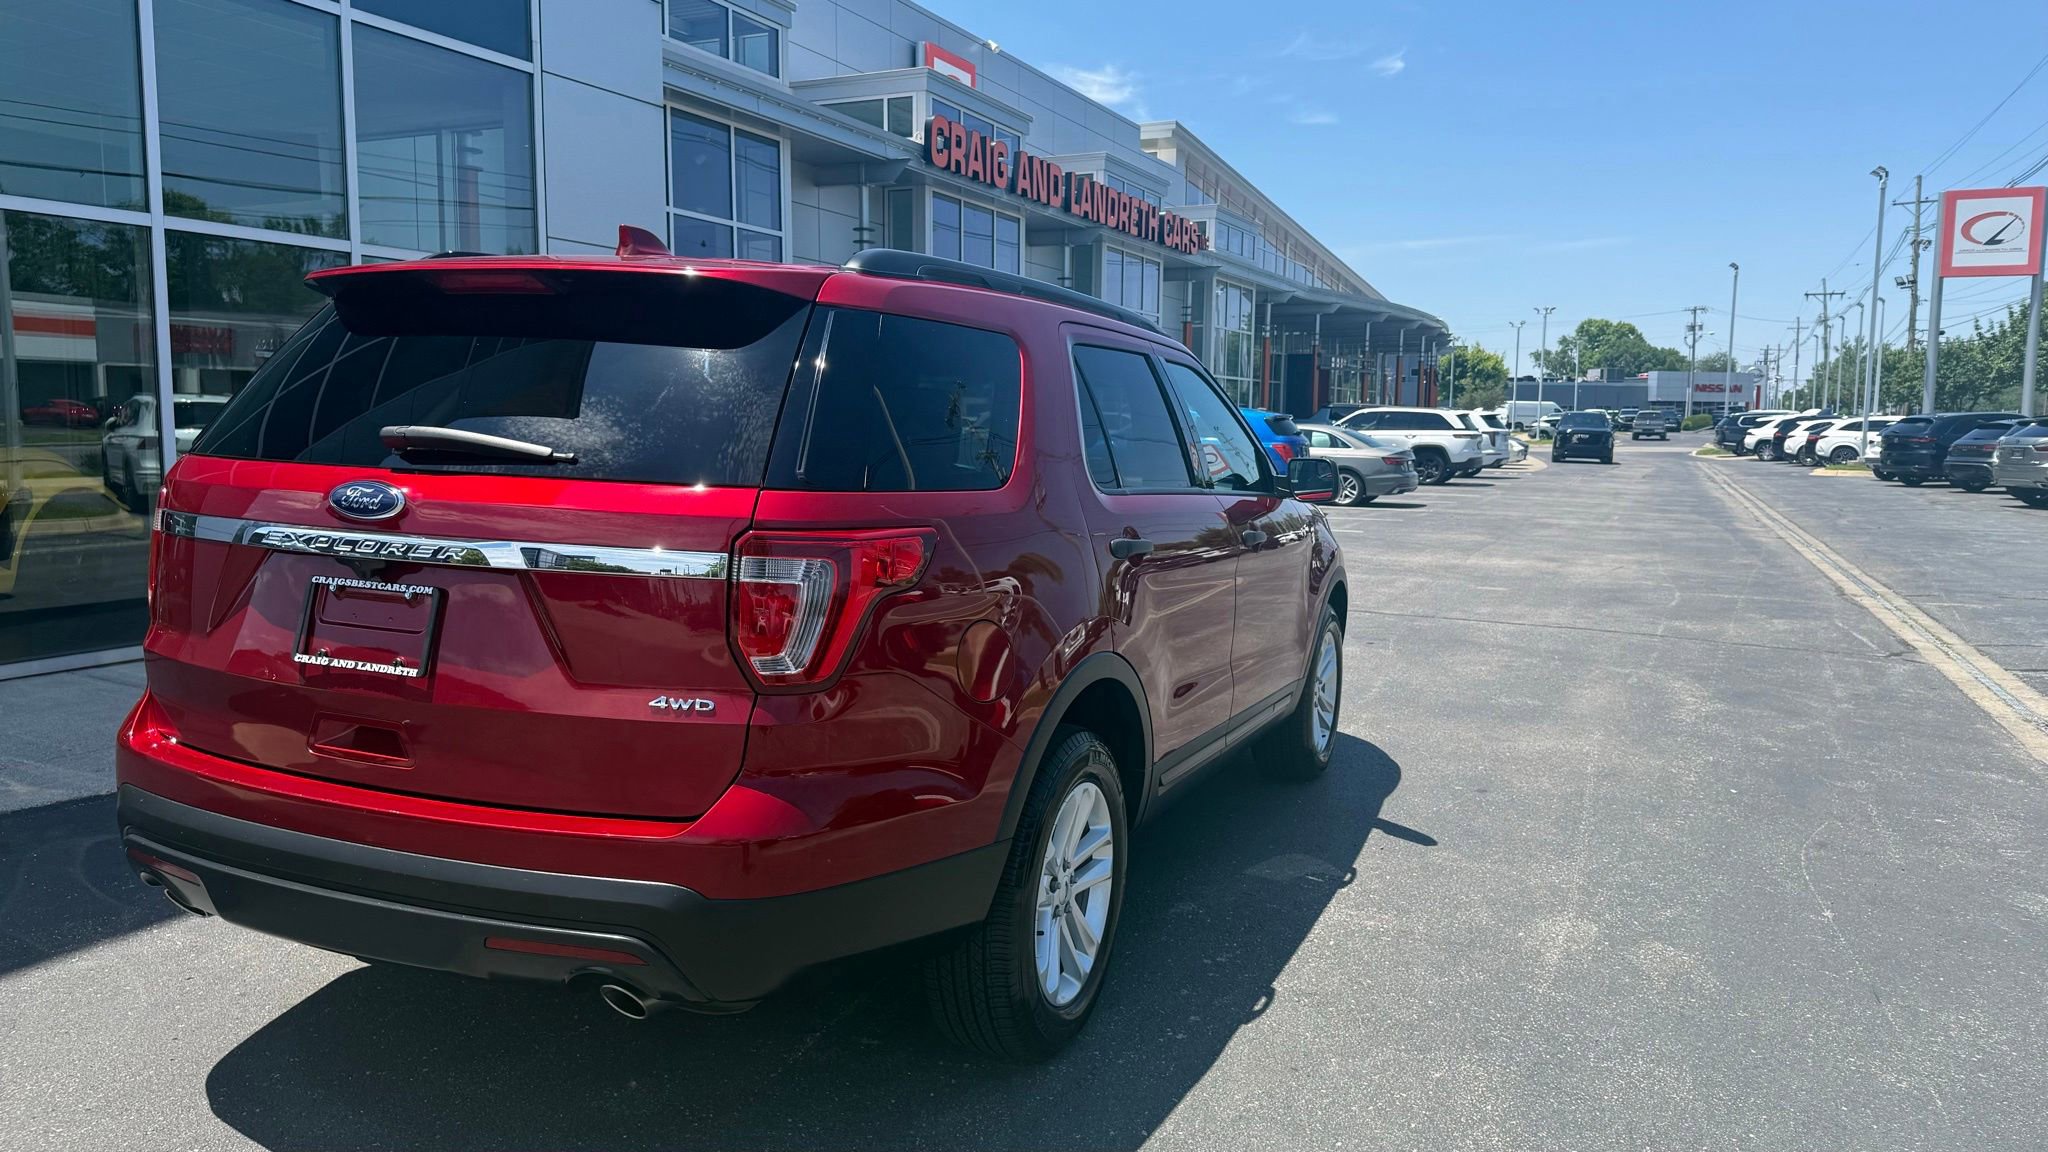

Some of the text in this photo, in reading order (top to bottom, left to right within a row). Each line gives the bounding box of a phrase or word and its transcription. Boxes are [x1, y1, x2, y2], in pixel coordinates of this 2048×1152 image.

[930, 114, 1008, 189] CRAIG
[1017, 150, 1063, 208] AND
[1071, 171, 1160, 242] LANDRETH
[1164, 210, 1199, 255] CARS
[1695, 383, 1743, 393] NISSAN
[341, 485, 383, 511] Ford
[262, 530, 468, 561] EXPLORER
[311, 575, 434, 595] CRAIGSBESTCARS.COM
[293, 653, 419, 678] CRAIG AND LANDRETH
[648, 695, 716, 711] 4WD
